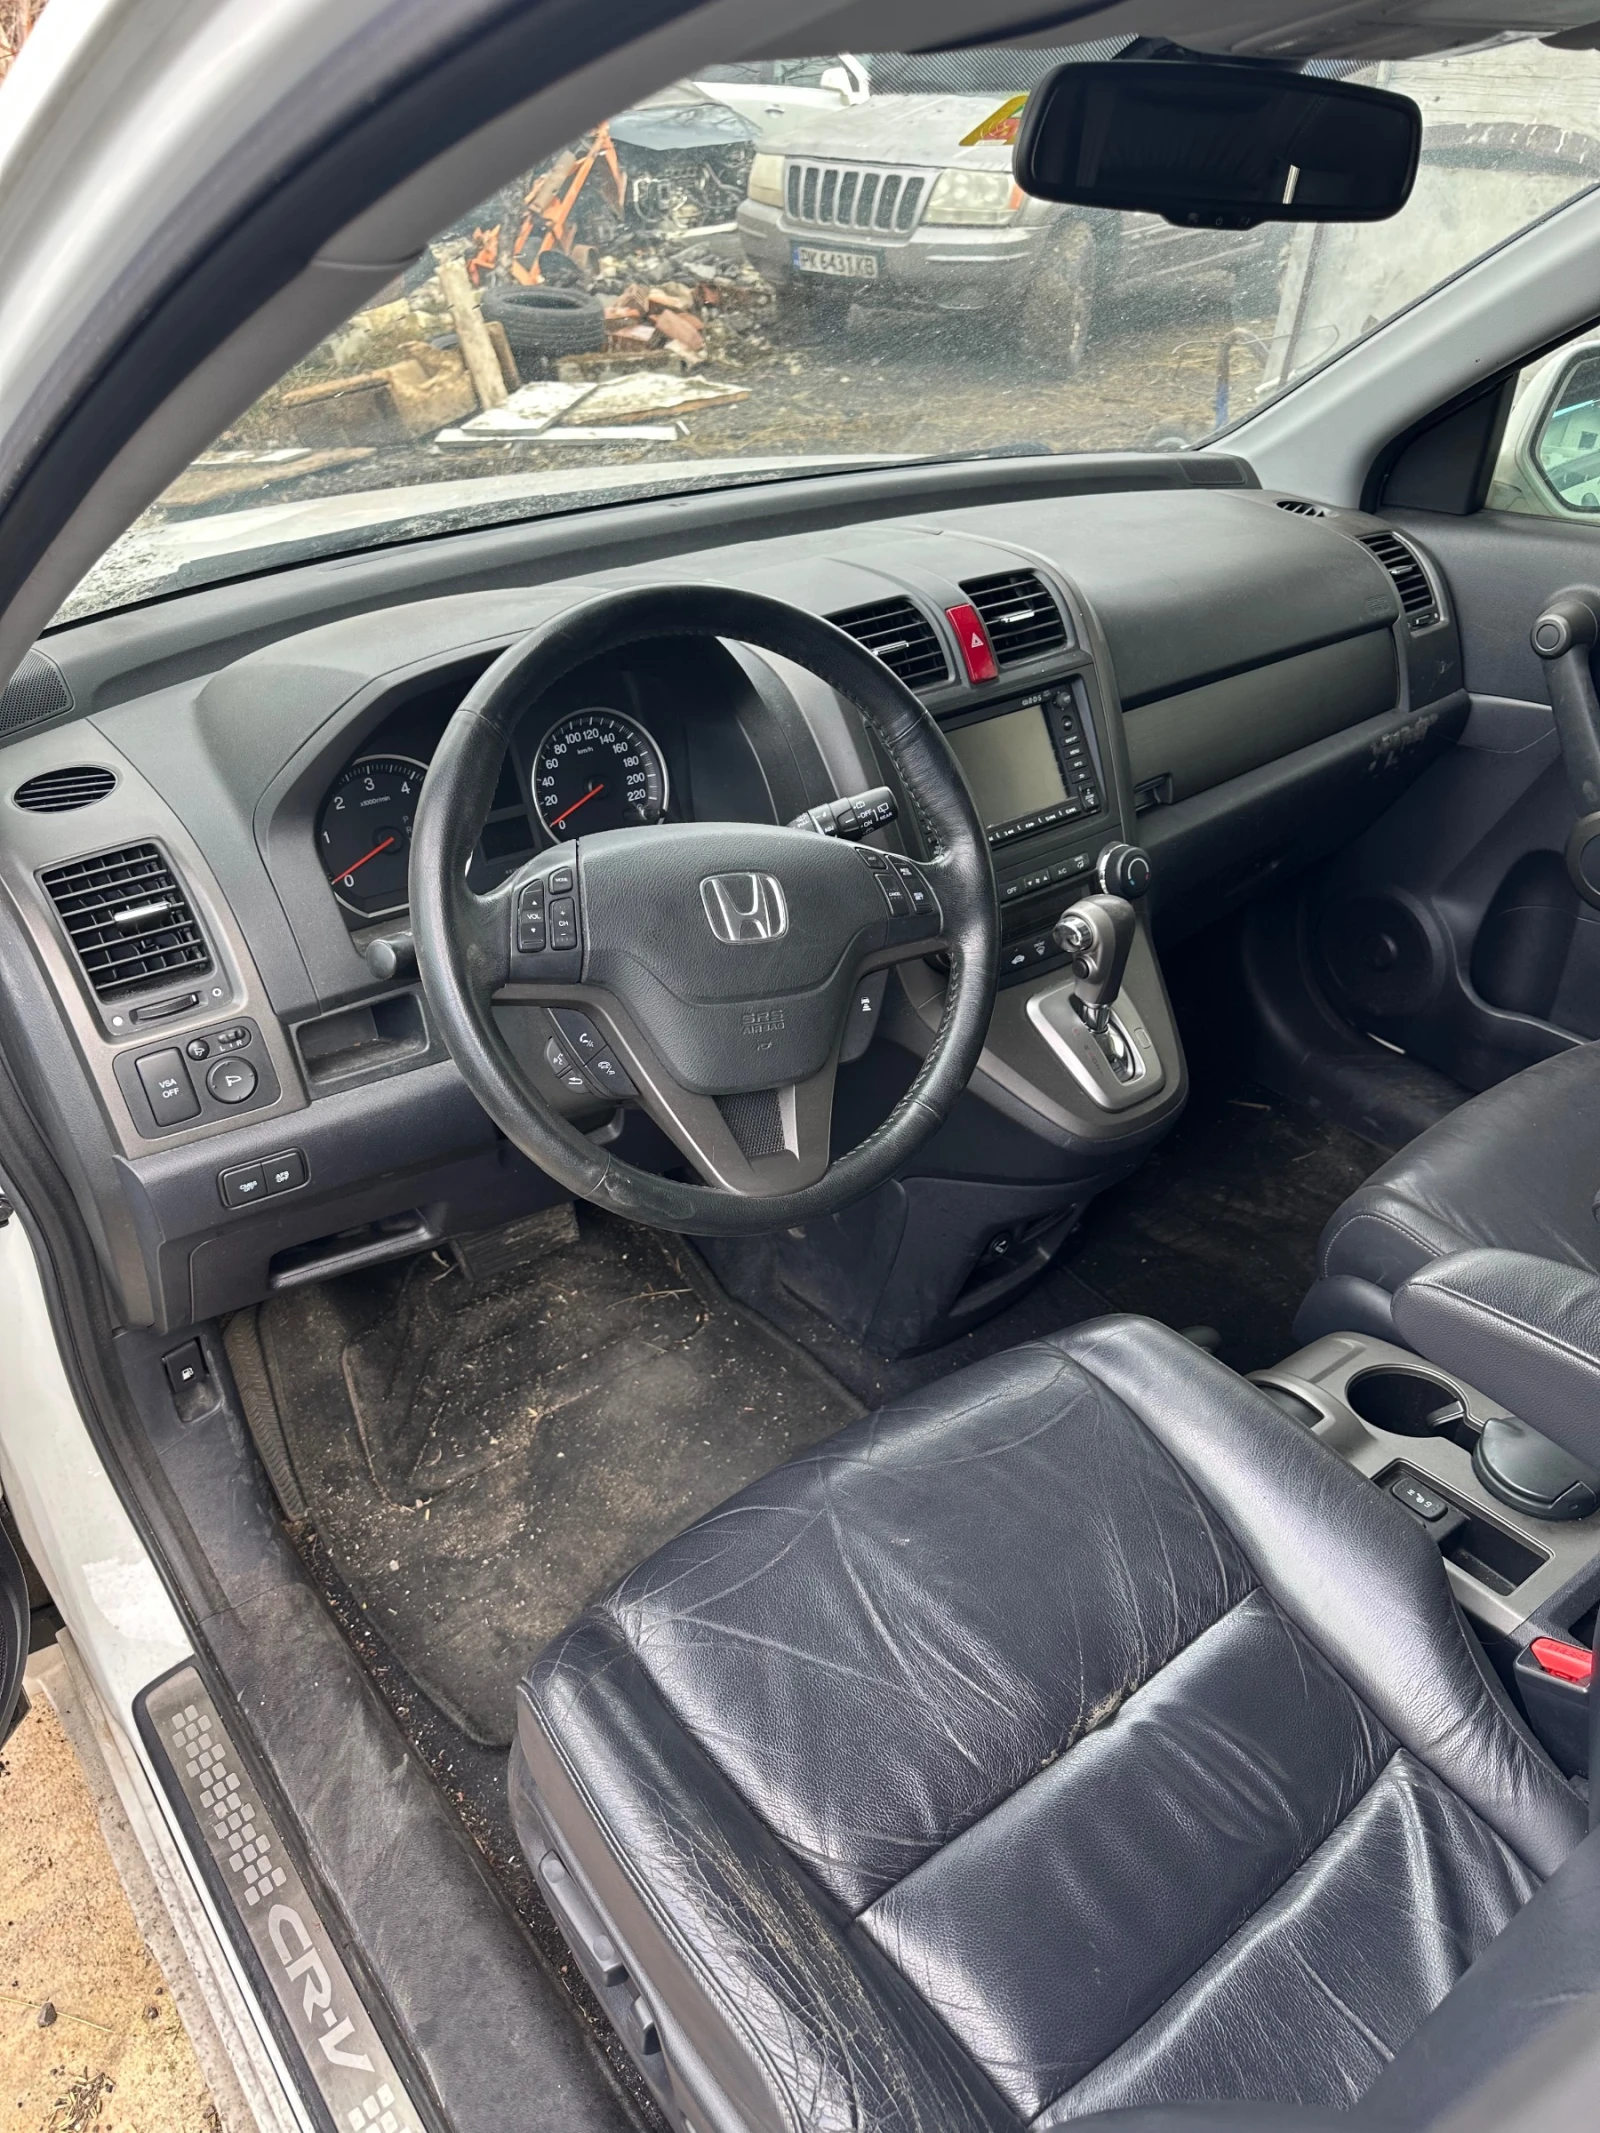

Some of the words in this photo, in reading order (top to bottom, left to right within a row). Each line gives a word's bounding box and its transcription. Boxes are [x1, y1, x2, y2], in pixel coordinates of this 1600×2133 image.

[565, 732, 581, 744] 100
[583, 728, 599, 740] 120
[599, 733, 615, 745] 140
[554, 743, 567, 755] 80
[577, 746, 594, 755] km/h
[612, 742, 628, 754] 160
[545, 758, 559, 770] 60
[623, 756, 639, 767] 180
[364, 777, 375, 791] 3
[542, 776, 555, 787] 40
[626, 772, 645, 785] 200
[401, 781, 411, 795] 4
[544, 794, 558, 806] 20
[627, 789, 646, 801] 220
[334, 796, 346, 810] 2
[860, 809, 872, 819] OFF
[558, 820, 566, 830] 0
[863, 819, 873, 828] ON
[323, 831, 331, 844] 1
[1057, 867, 1067, 875] A/C
[344, 874, 355, 888] 0
[1006, 886, 1017, 895] OFF
[742, 1010, 784, 1025] SRS
[158, 1078, 177, 1089] VSA
[162, 1087, 179, 1098] OFF
[268, 1903, 375, 2074] CR-V
